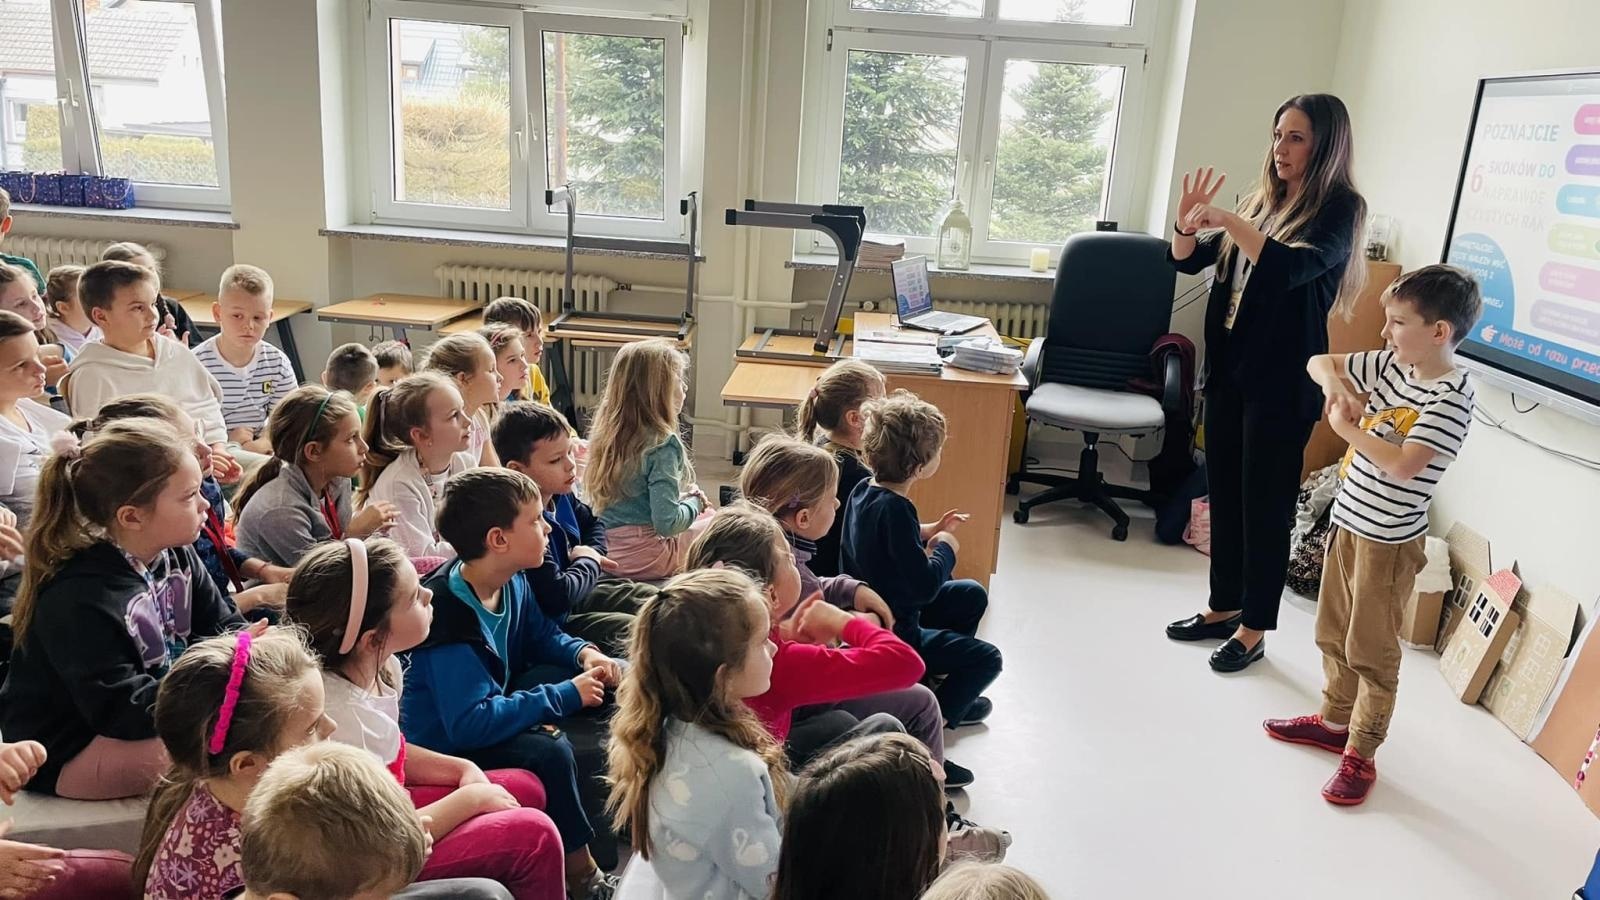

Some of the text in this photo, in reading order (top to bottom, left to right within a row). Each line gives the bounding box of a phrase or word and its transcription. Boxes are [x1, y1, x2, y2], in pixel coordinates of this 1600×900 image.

[1483, 123, 1560, 142] POZNAJCIE
[1470, 164, 1485, 193] 6
[1538, 163, 1556, 179] DO
[1499, 332, 1525, 350] Może
[1528, 343, 1543, 356] od
[1545, 349, 1568, 364] razu
[262, 380, 273, 394] C
